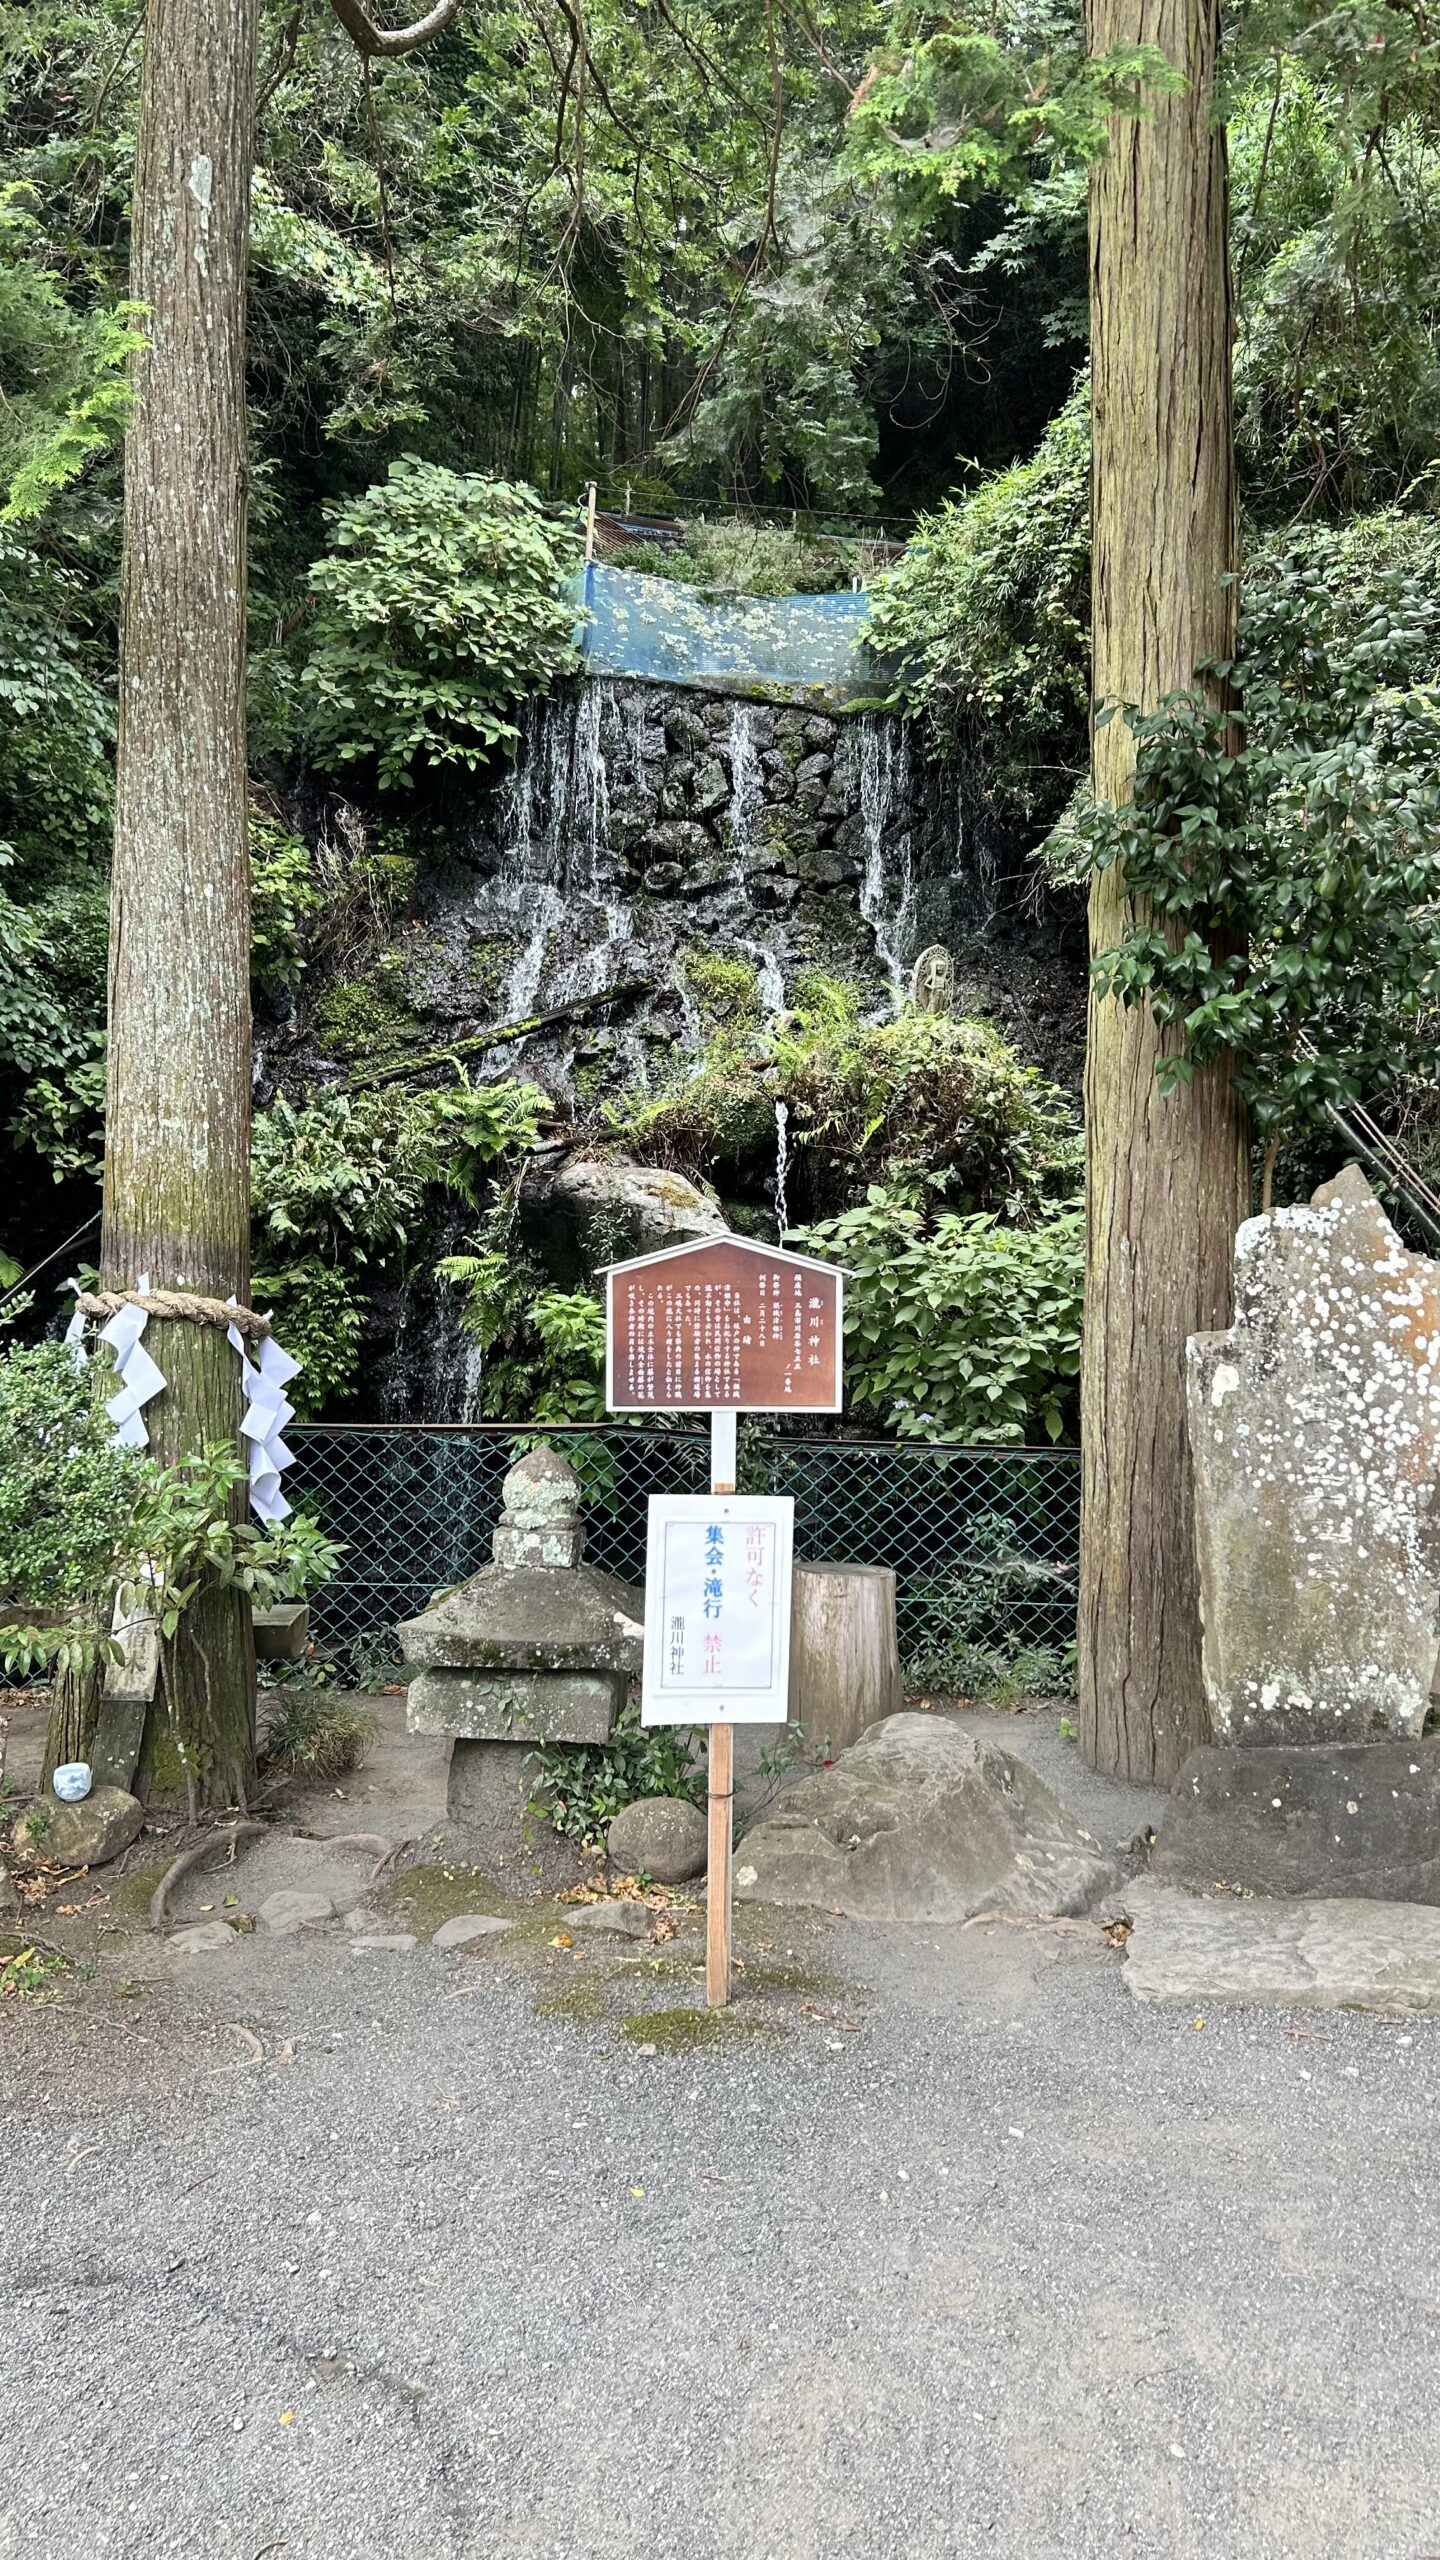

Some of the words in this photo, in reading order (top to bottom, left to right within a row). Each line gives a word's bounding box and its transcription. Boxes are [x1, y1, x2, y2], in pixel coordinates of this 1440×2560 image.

[656, 1284, 664, 1304] れる。
[742, 1314, 752, 1345] 由緒
[758, 1302, 766, 1347] 二月二十八日
[703, 1525, 725, 1619] 集会・滝行
[746, 1525, 766, 1608] 許可なく
[670, 1615, 686, 1676] 瀧川神社
[703, 1632, 723, 1675] 禁止
